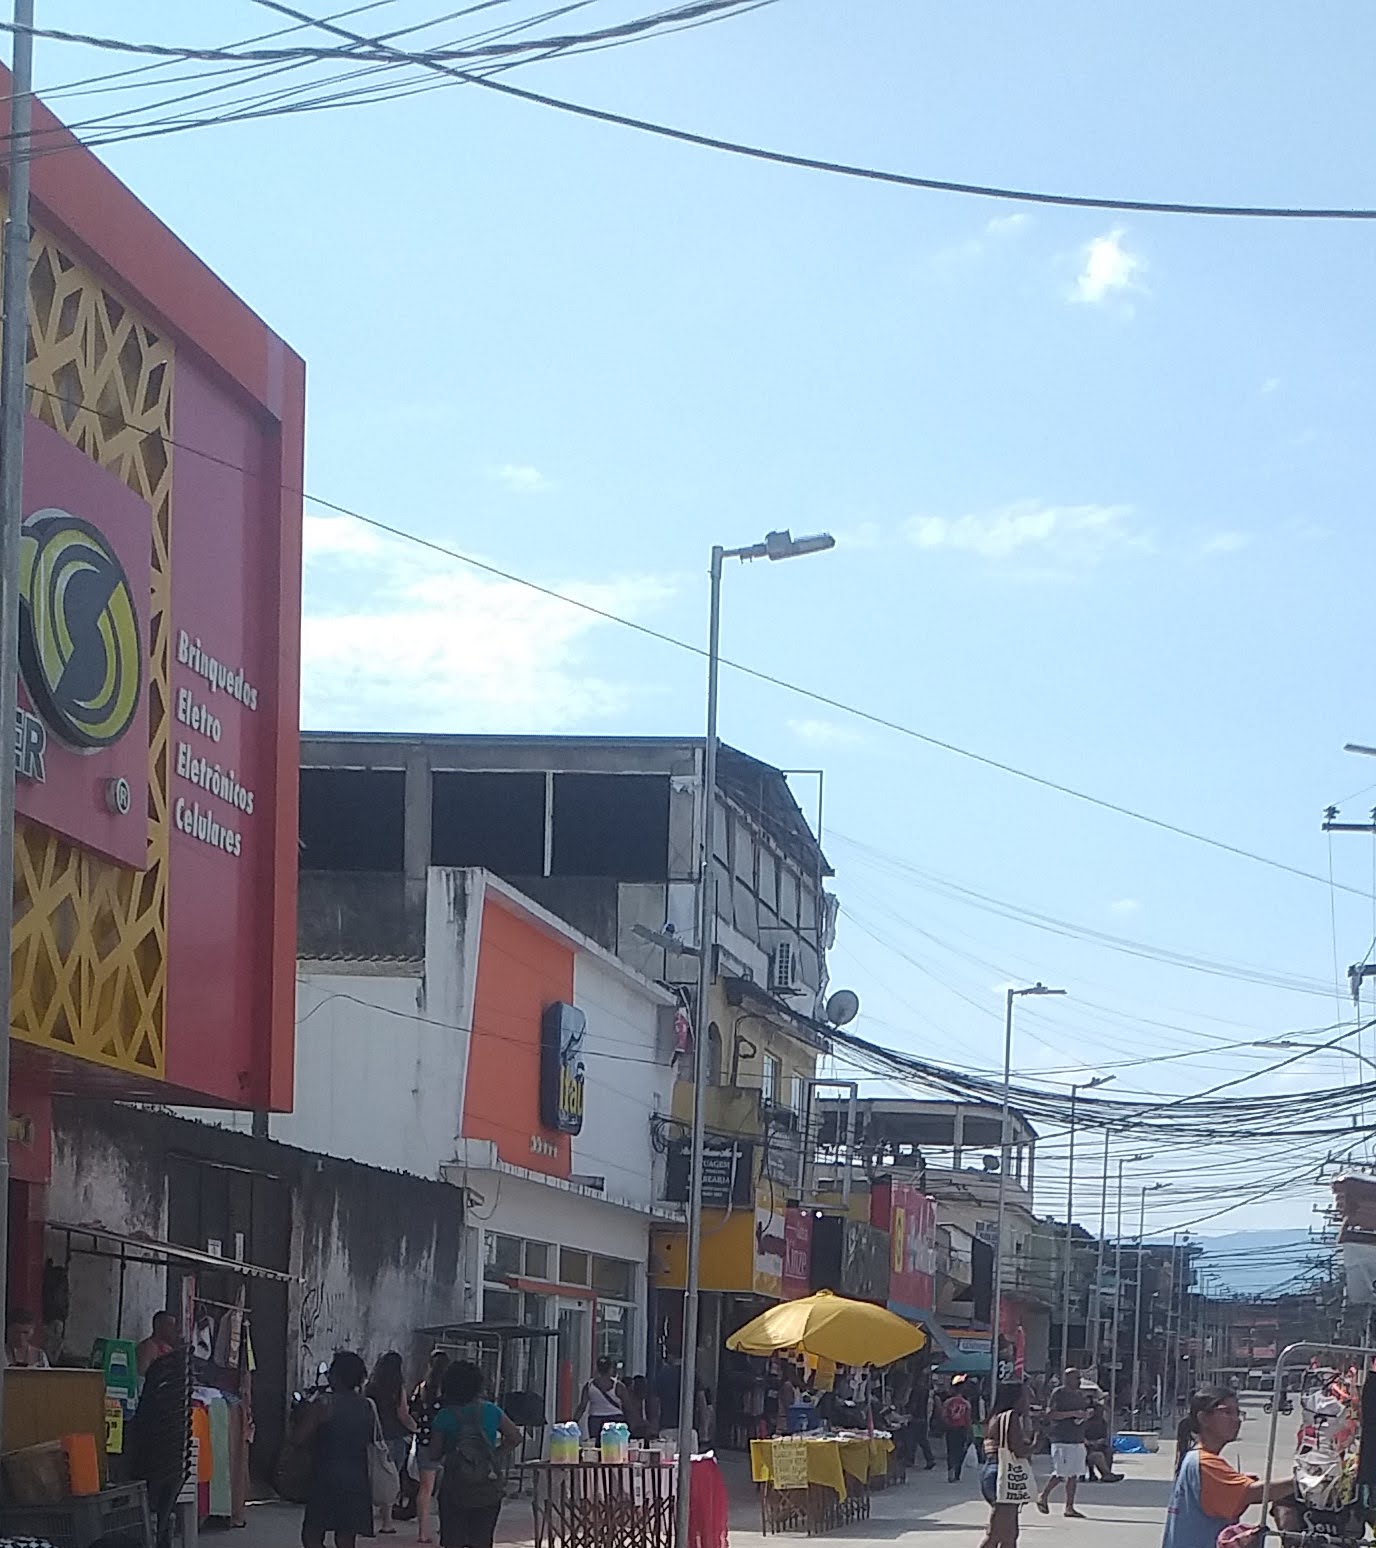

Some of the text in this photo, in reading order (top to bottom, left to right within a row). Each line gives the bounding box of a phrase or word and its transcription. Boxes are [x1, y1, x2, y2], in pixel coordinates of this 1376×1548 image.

[177, 629, 259, 712] Brinquedos
[177, 687, 222, 742] Eletro
[176, 740, 254, 815] Eletrônicos
[175, 797, 242, 857] Celulares
